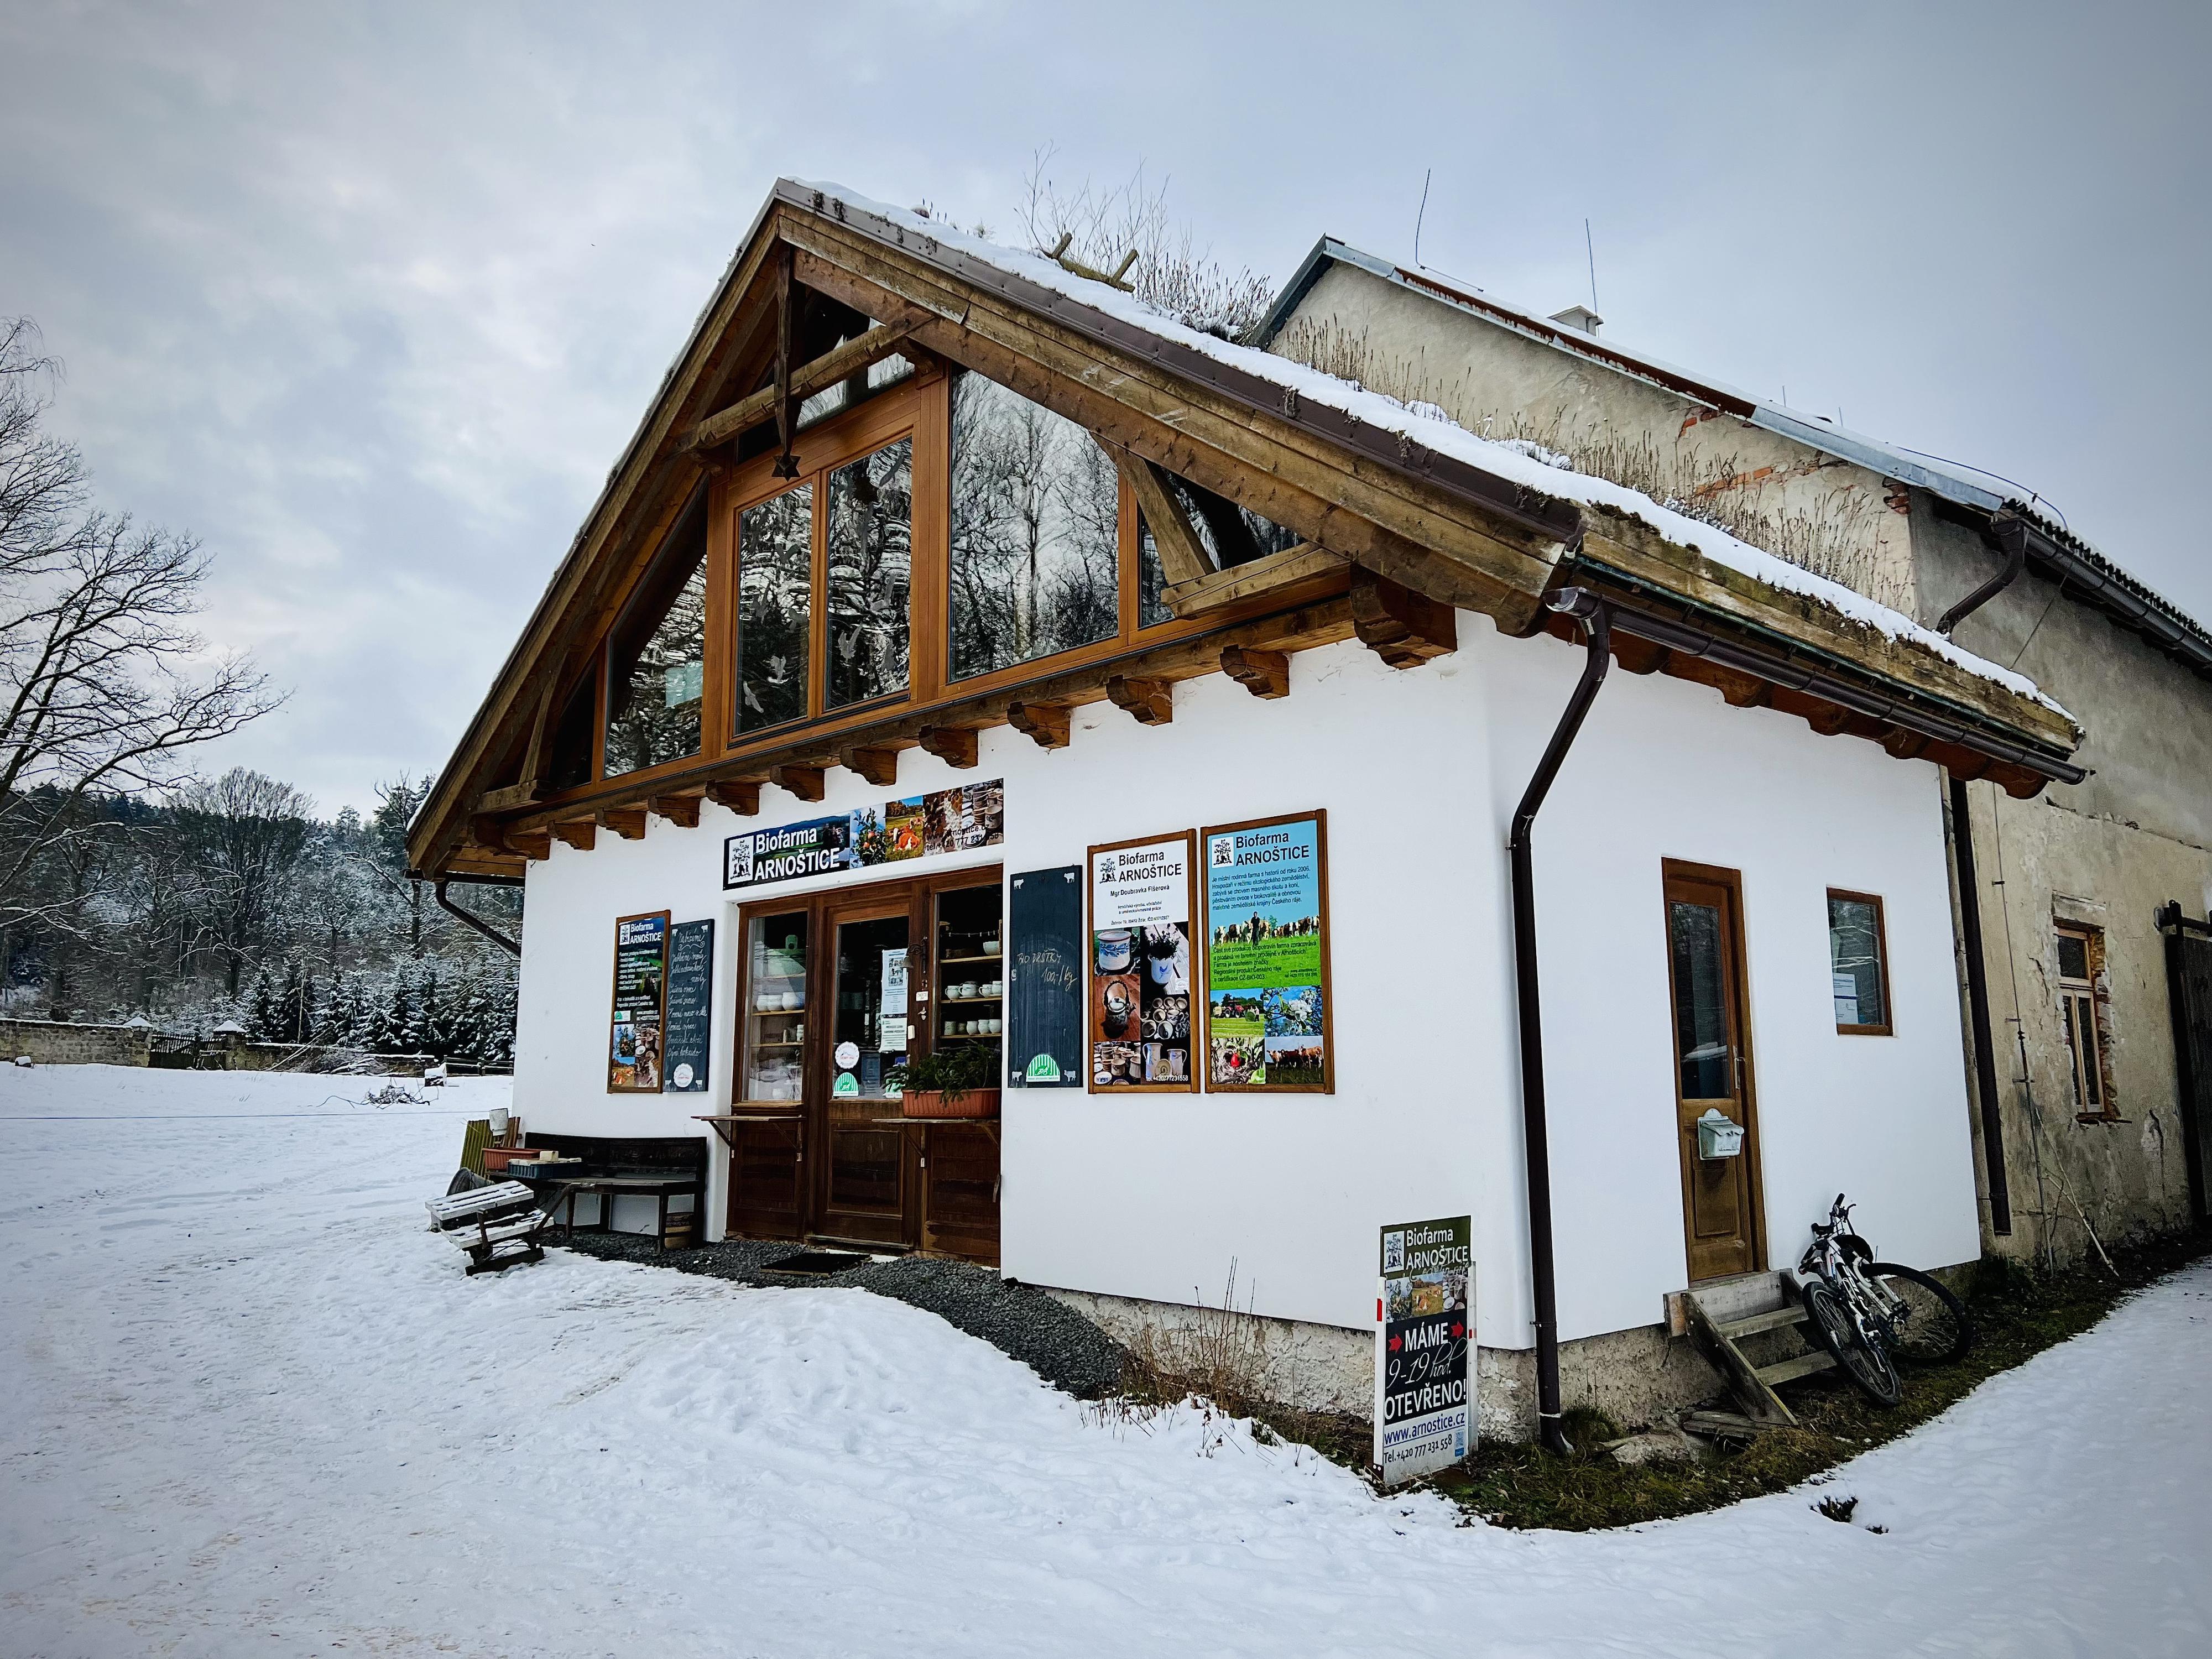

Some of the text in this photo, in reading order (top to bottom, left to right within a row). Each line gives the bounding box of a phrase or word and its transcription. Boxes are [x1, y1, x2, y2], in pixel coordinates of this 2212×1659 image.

[756, 828, 817, 853] Biofarma
[1236, 833, 1289, 848] Biofarma
[754, 847, 840, 881] ARNOŠTICE
[1119, 852, 1164, 866] Biofarma
[1235, 845, 1309, 867] ARNOŠTICE
[1119, 864, 1181, 882] ARNOŠTICE
[630, 922, 653, 932] Biofarma
[630, 932, 661, 944] ARNOŠTICE
[1407, 1227, 1453, 1246] Biofarma
[1406, 1245, 1468, 1270] ARNOŠTICE
[1405, 1322, 1448, 1352] MÁME
[1386, 1352, 1430, 1389] 9-19
[1384, 1379, 1467, 1420] OTEVŘENO!
[1385, 1412, 1465, 1444] www.arnostice.cz
[1415, 1444, 1426, 1458] 777
[1428, 1441, 1439, 1453] 231
[1441, 1434, 1452, 1451] 558
